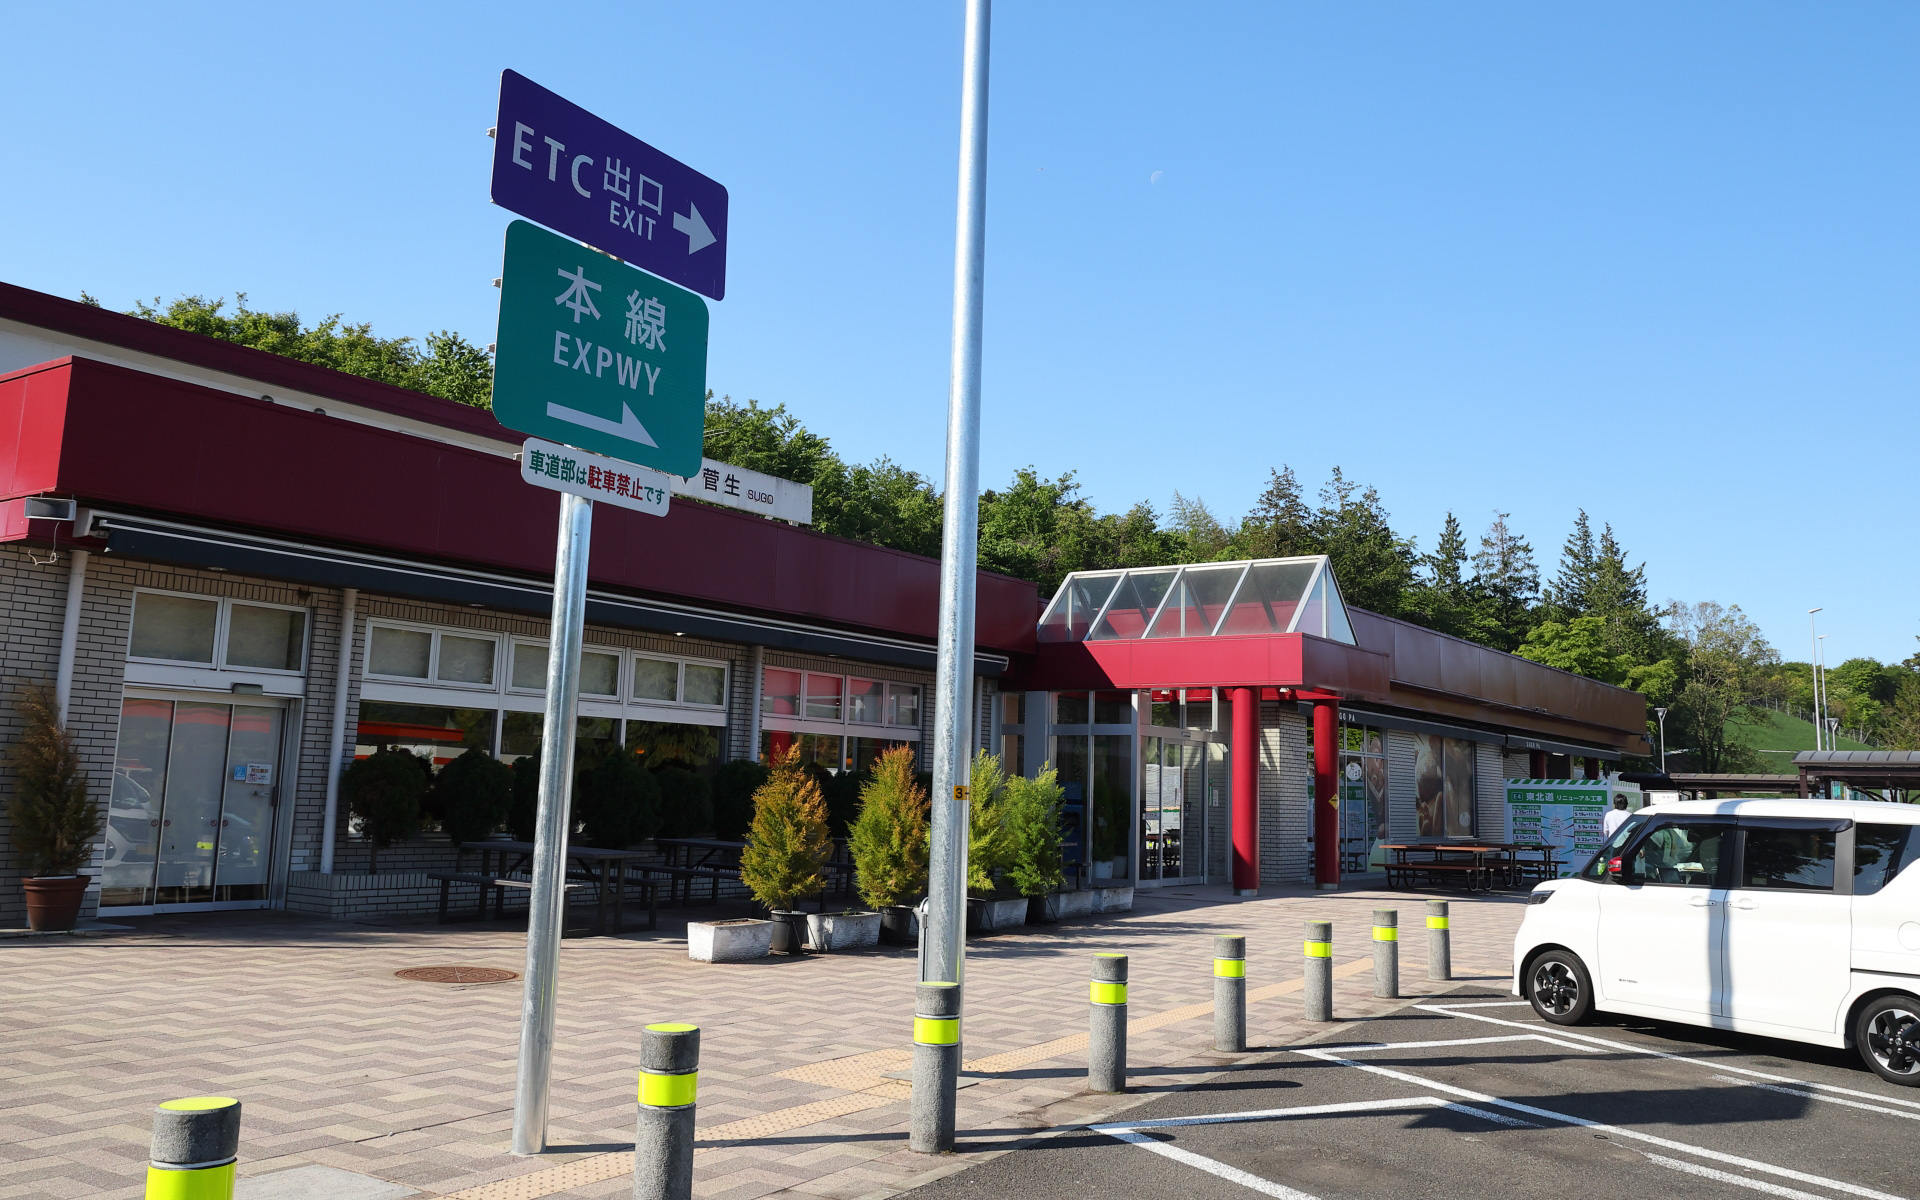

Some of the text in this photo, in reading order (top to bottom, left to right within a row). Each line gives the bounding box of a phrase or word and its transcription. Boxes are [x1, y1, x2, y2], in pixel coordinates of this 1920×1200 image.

[512, 121, 663, 216] ETC 出口
[609, 200, 656, 241] EXIT
[555, 266, 666, 353] 本線
[553, 330, 661, 396] EXPWY
[747, 489, 774, 505] SUGO
[1526, 792, 1554, 801] 東北道
